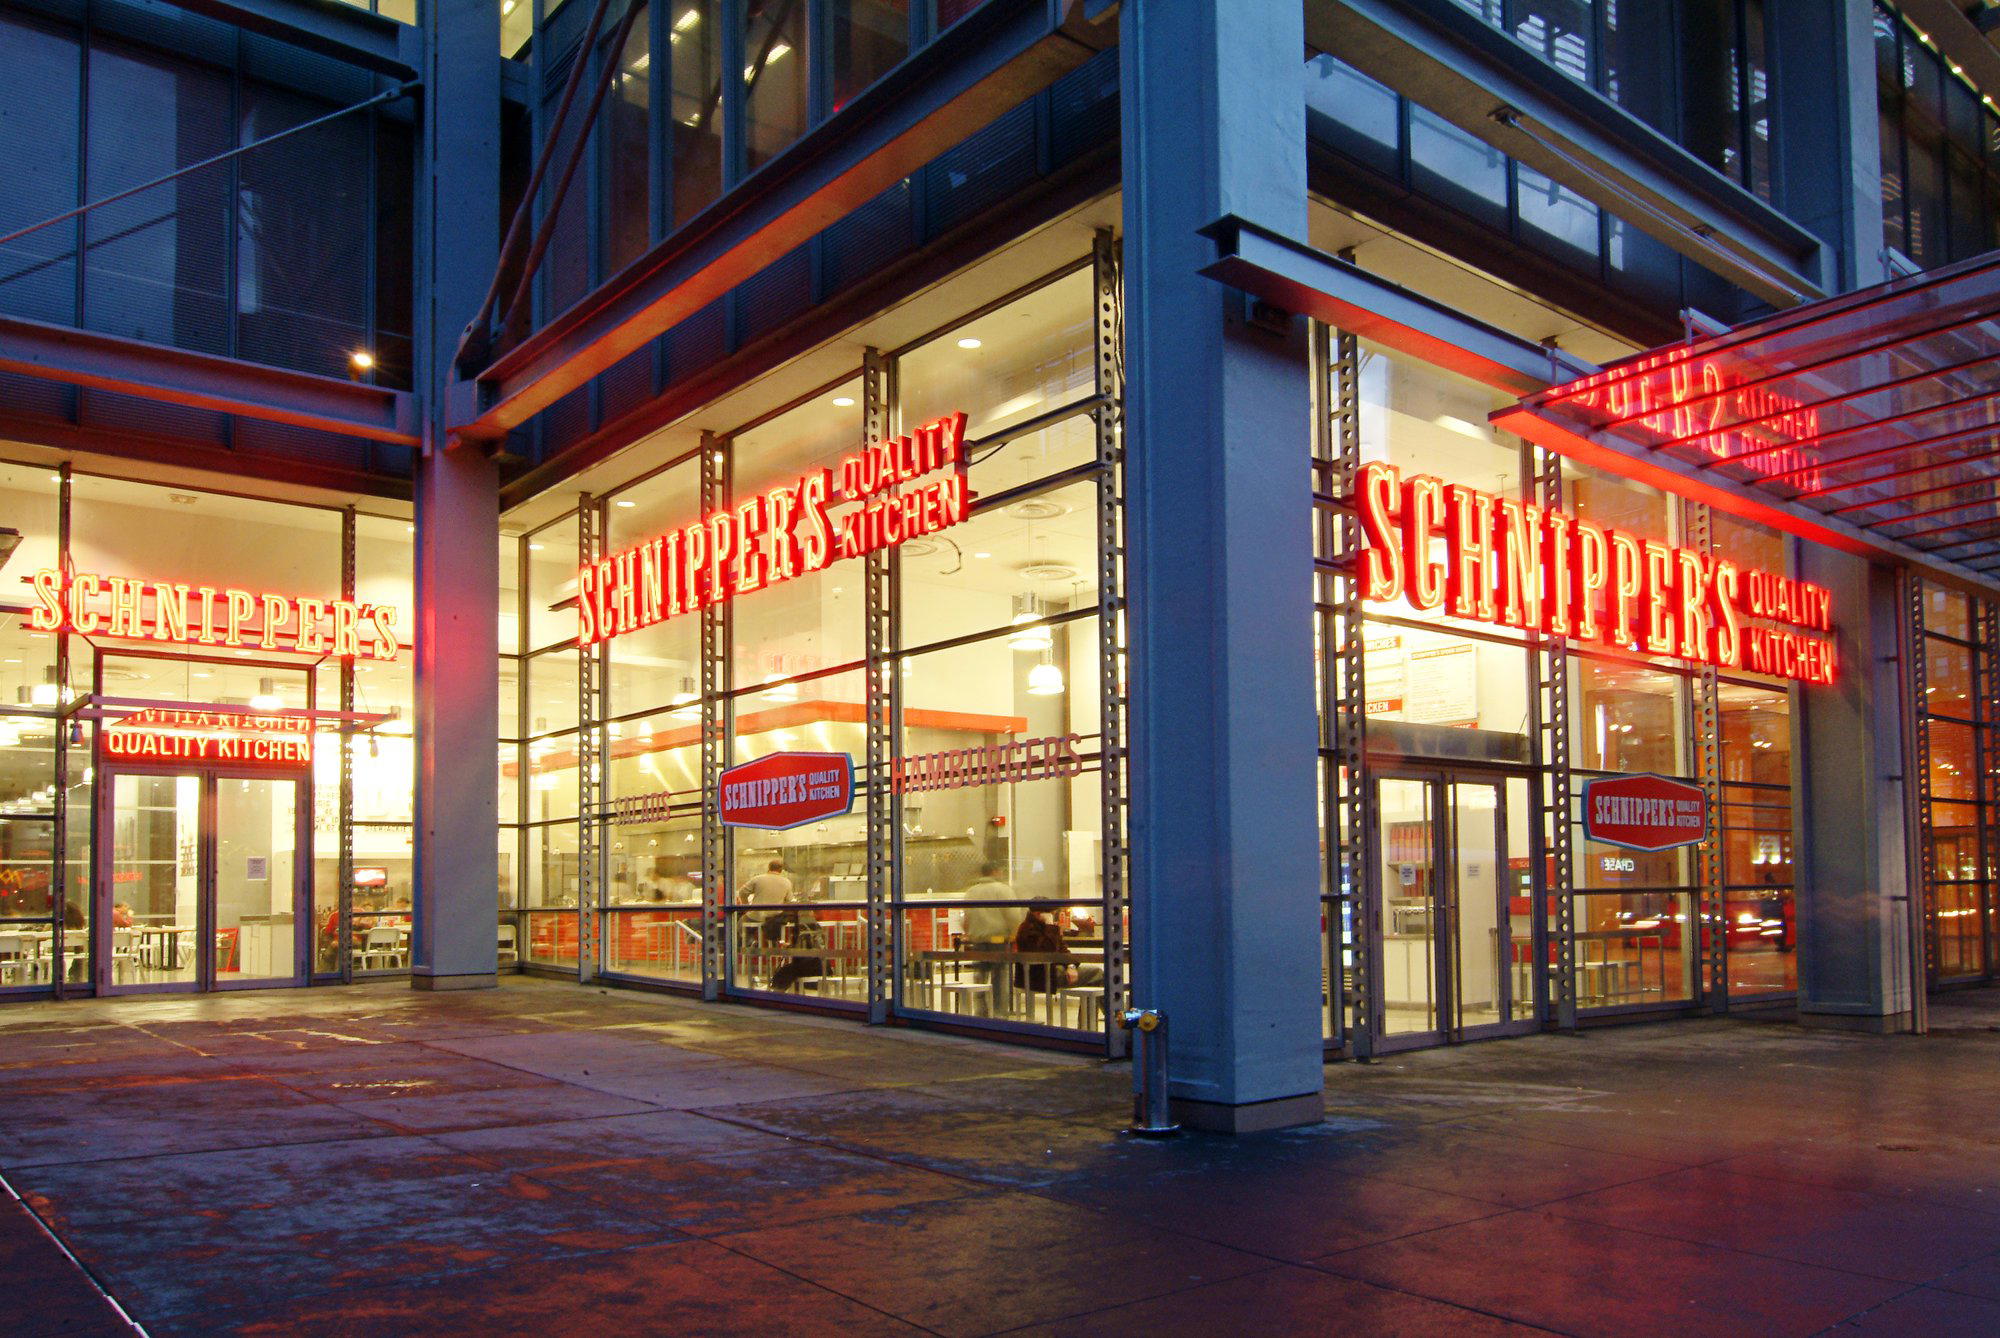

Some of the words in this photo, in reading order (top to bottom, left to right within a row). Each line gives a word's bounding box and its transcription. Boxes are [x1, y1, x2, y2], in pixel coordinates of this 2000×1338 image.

[841, 411, 970, 499] QUALITY
[840, 474, 970, 560] KITCHEN
[578, 467, 835, 646] SCHNIPPER'S
[1355, 461, 1741, 668] SCHNIPPER'S
[32, 567, 399, 662] SCHNIPPER'S
[1743, 567, 1832, 631] QUALITY
[1743, 627, 1836, 685] KITCHEN
[108, 731, 211, 757] QUALITY
[217, 737, 311, 761] KITCHEN
[890, 732, 1083, 796] HAMBURGERS
[613, 790, 671, 826] SALADS
[724, 772, 808, 811] SCHNIPPER'S
[809, 769, 840, 786] QUALITY
[809, 785, 841, 801] KITCHEN
[1595, 795, 1675, 827] SCHNIPPER'S
